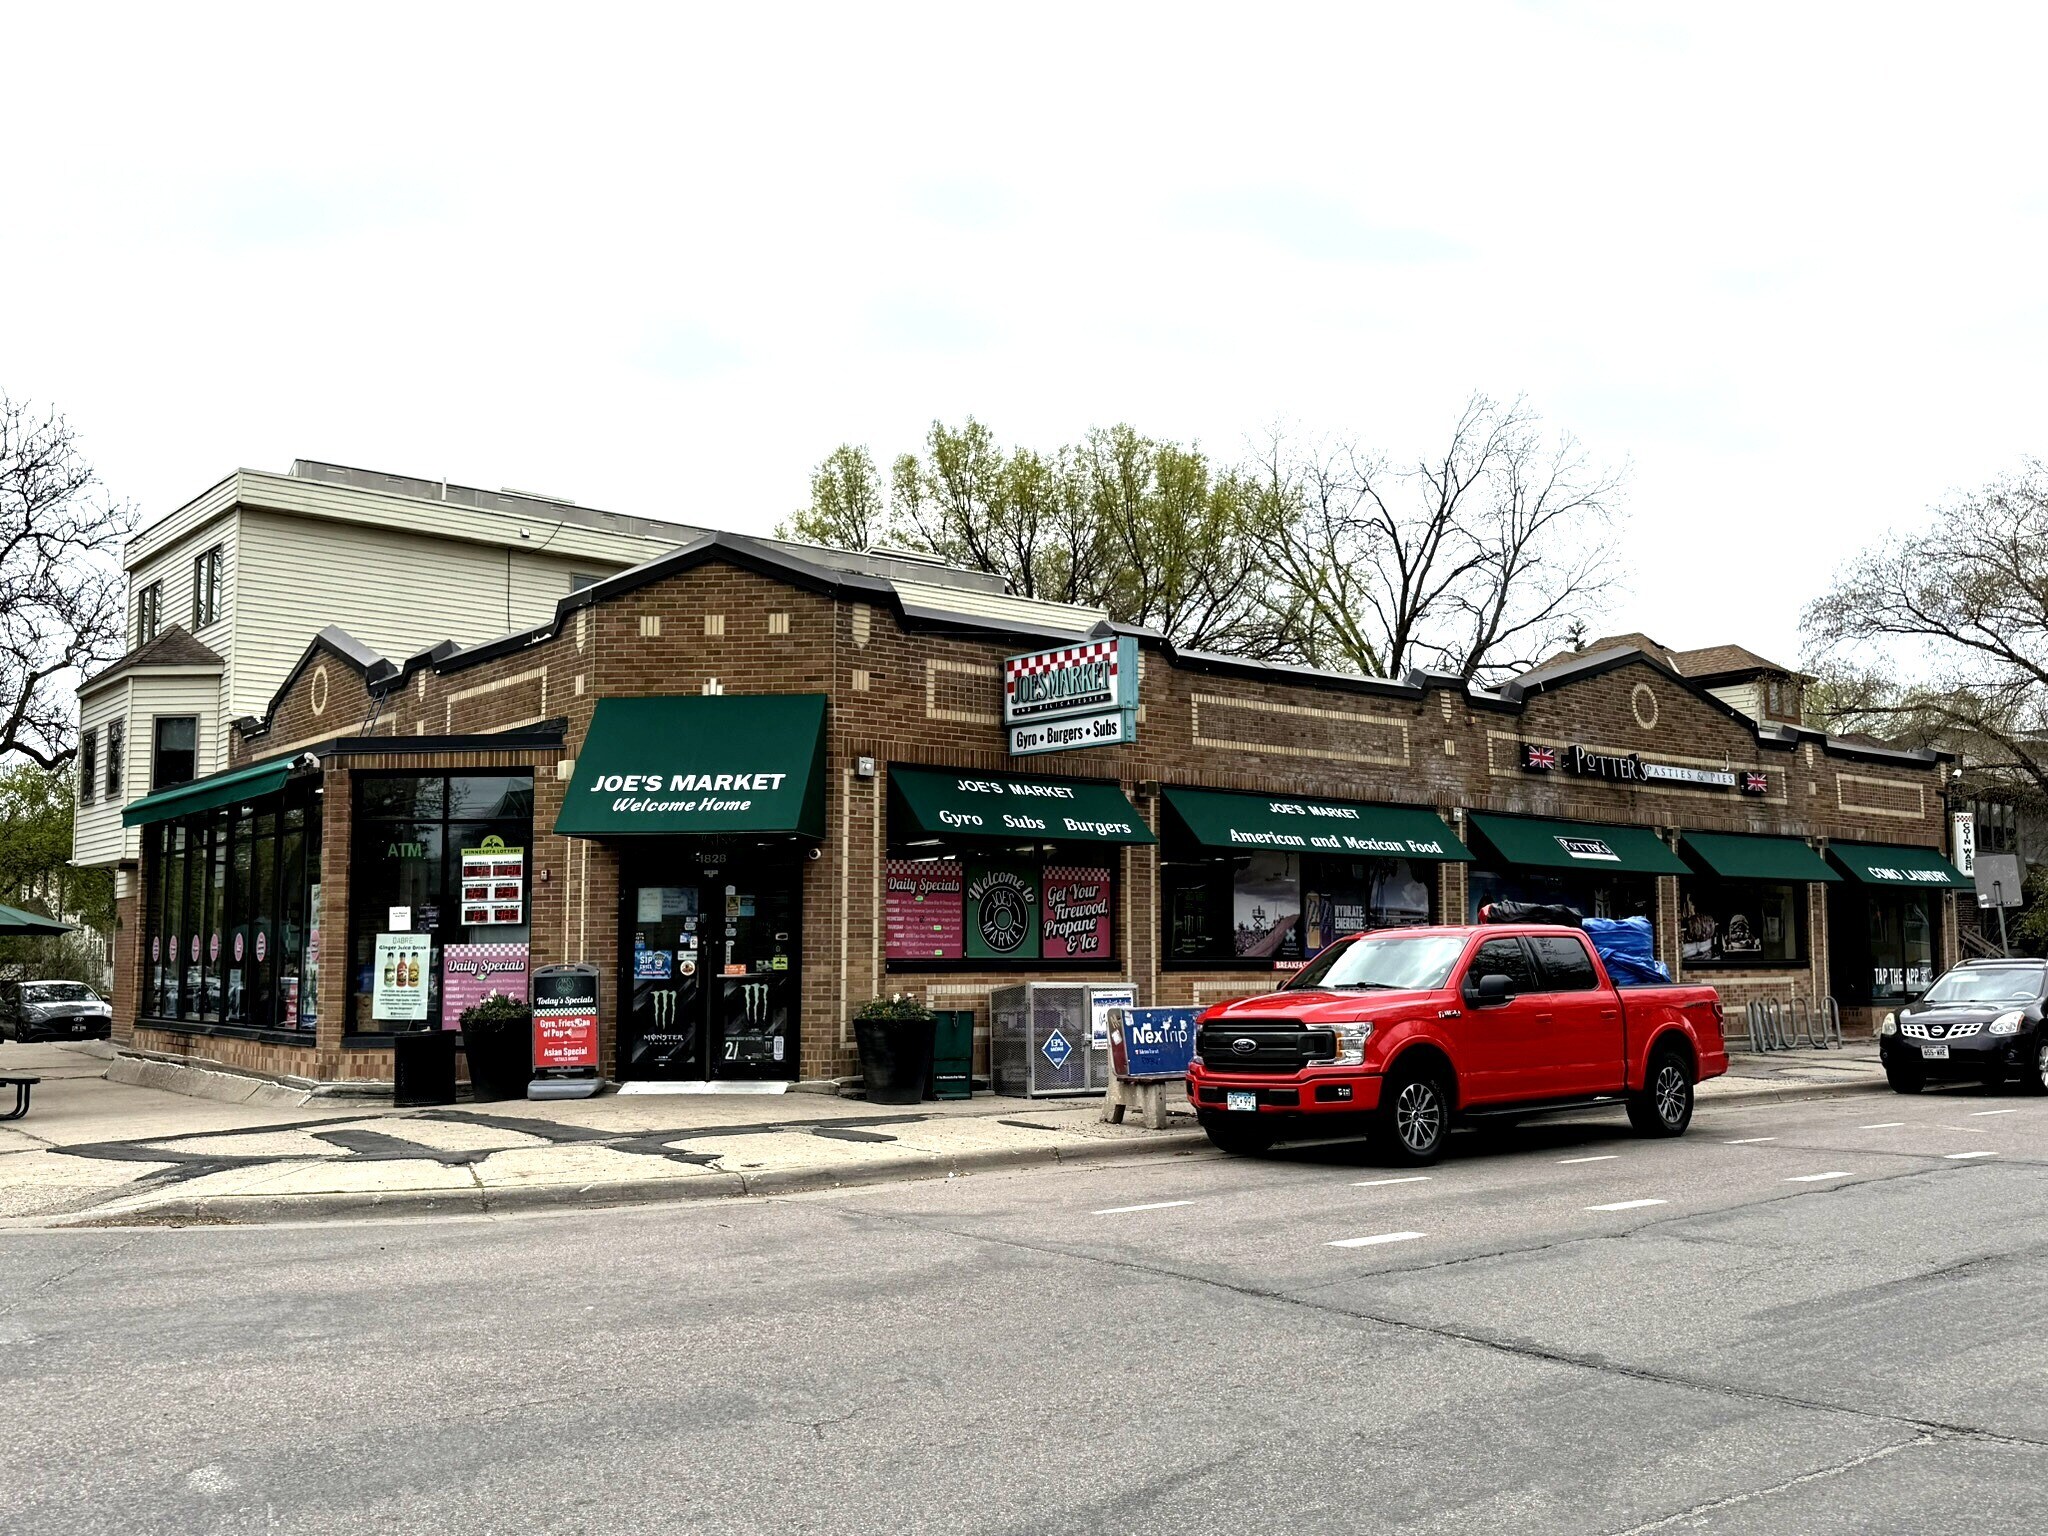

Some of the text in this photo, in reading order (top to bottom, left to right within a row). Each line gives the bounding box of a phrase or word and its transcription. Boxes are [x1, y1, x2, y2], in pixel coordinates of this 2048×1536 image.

[1017, 718, 1117, 749] Gyro Burgers Subs
[590, 773, 786, 792] JOE'S MARKET
[1697, 772, 1706, 782] &
[1710, 772, 1733, 784] PIES
[957, 779, 1075, 799] JOE'S MARKET
[612, 797, 752, 812] Welcome Home
[1269, 802, 1360, 820] JOE'S MARKET
[939, 810, 1132, 836] Gyro Subs Burgers
[1230, 829, 1444, 855] American and Mexican Food
[1963, 823, 1971, 845] COIN
[388, 843, 422, 857] ATM
[700, 854, 727, 863] 1828
[1963, 848, 1973, 871] WASH
[1867, 867, 1951, 882] COMO LAUNDRY
[888, 877, 959, 894] Daily Specials
[968, 871, 1035, 903] Welcome to
[1048, 882, 1099, 907] Get Your
[992, 890, 1014, 908] JOE'S
[1055, 898, 1109, 921] Firewood,
[1335, 905, 1365, 917] HYDRATE.
[983, 919, 1023, 946] MARKET
[1044, 917, 1096, 939] Propane
[1066, 934, 1098, 953] & Ice
[448, 960, 524, 975] Daily Specials
[640, 956, 653, 964] SIP
[1874, 968, 1919, 985] TAP THE APP
[537, 995, 593, 1006] Today's Specials
[540, 1020, 558, 1029] Gyro,
[543, 1029, 564, 1038] of Pop
[1133, 1022, 1188, 1048] NexTrip
[544, 1047, 588, 1057] Asian Special
